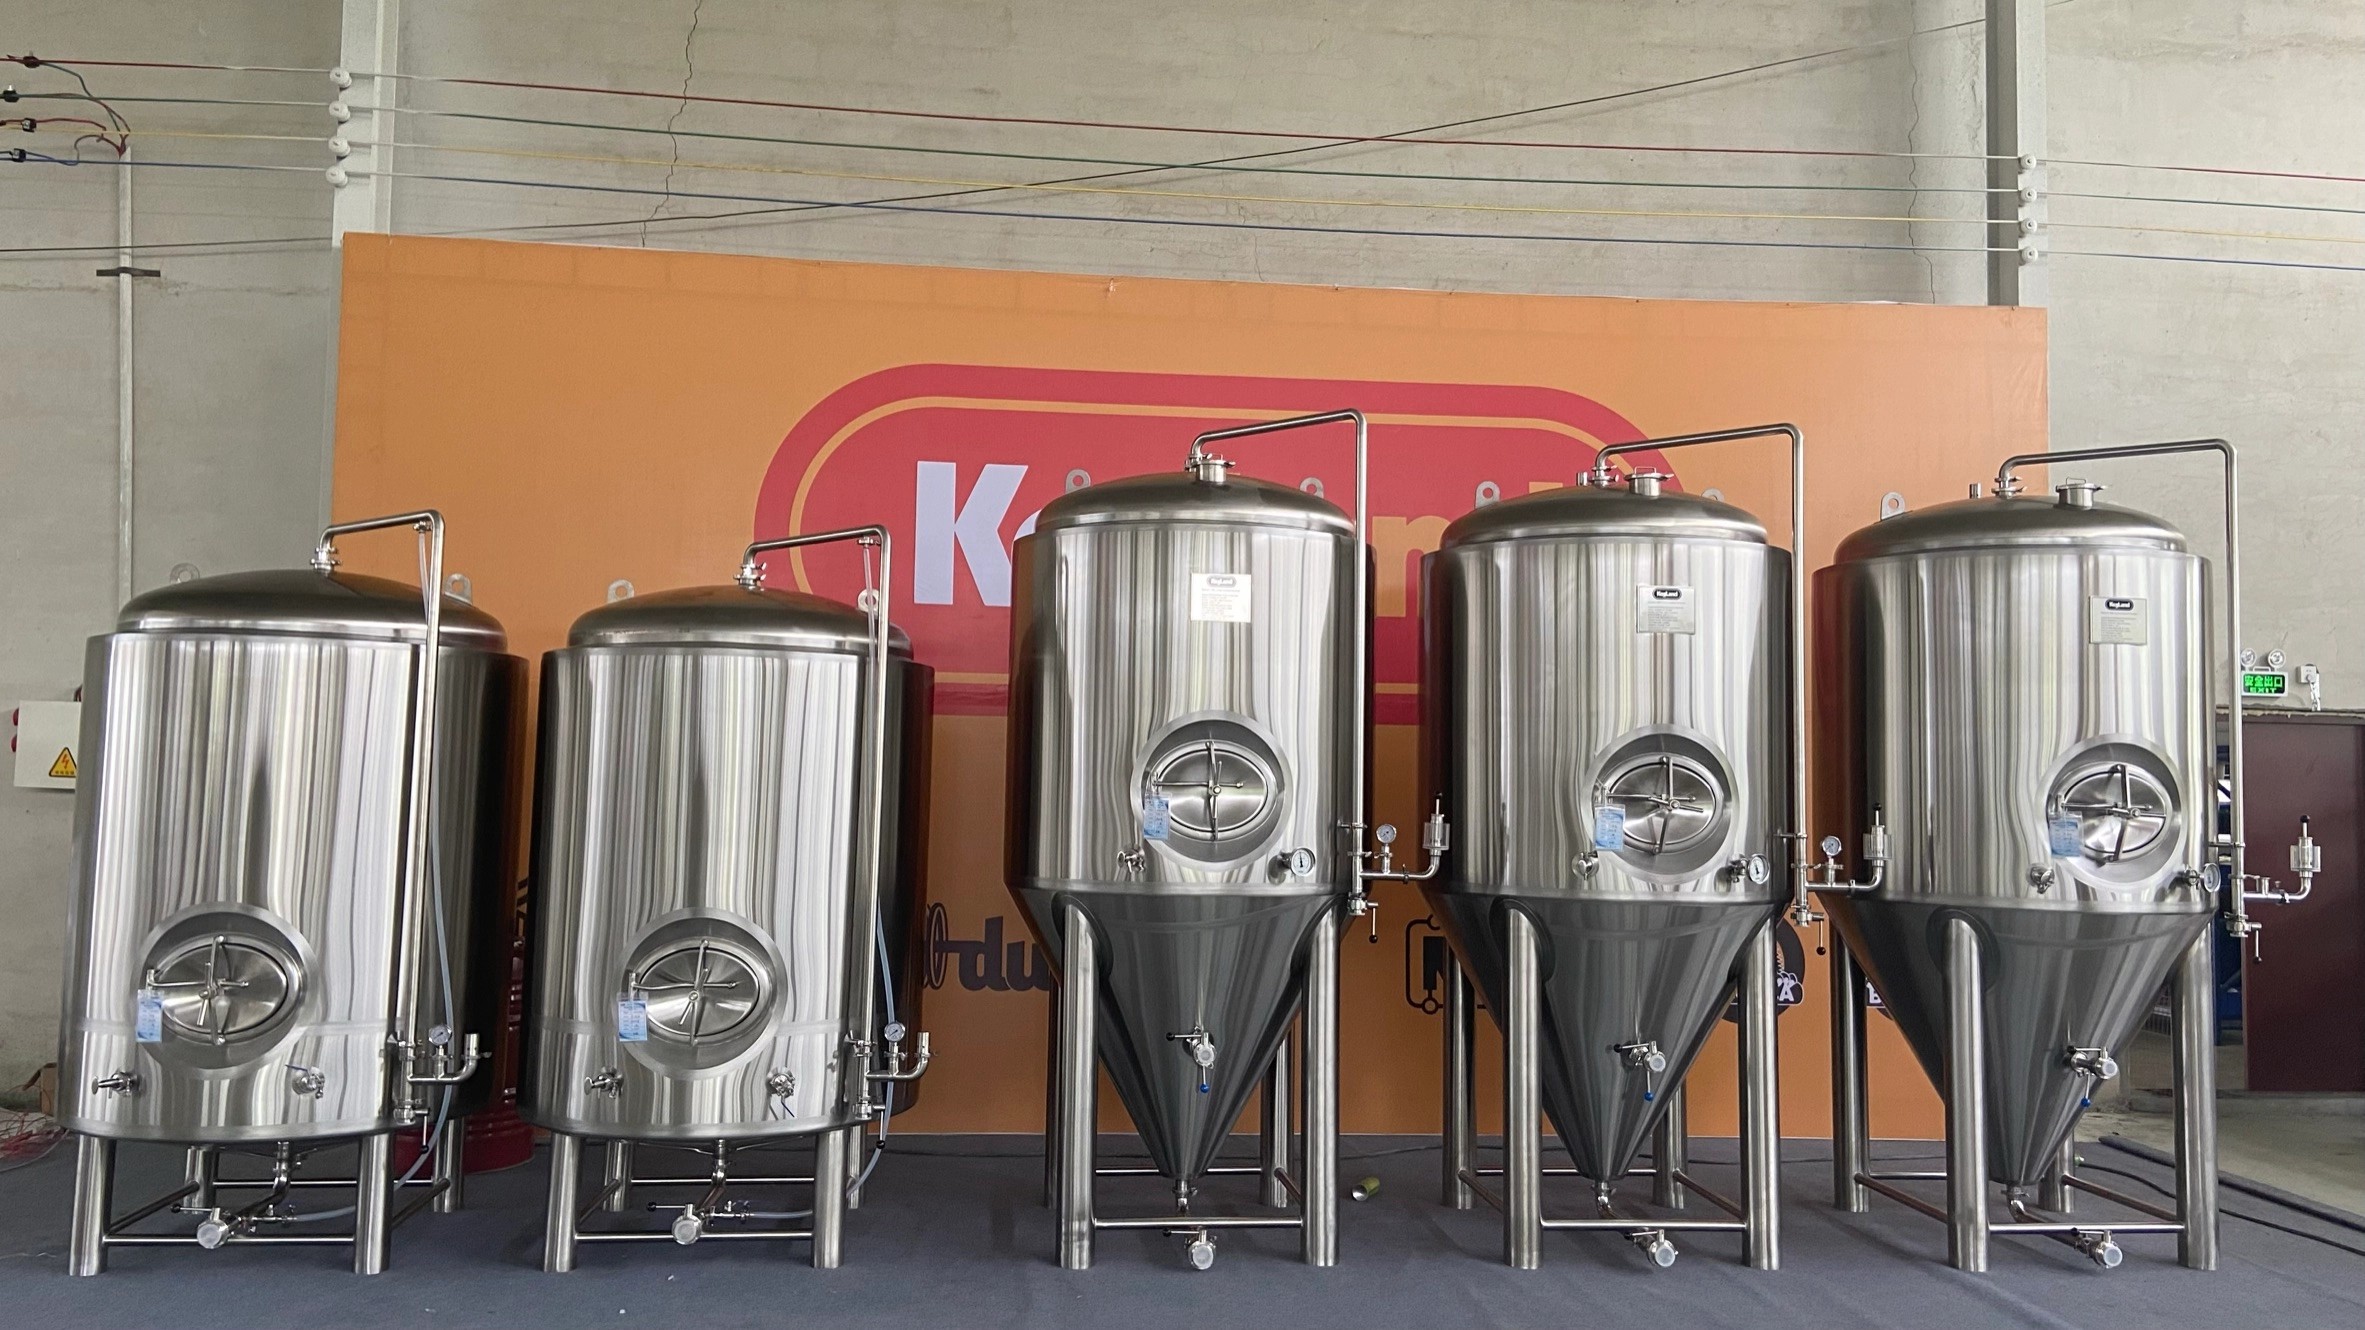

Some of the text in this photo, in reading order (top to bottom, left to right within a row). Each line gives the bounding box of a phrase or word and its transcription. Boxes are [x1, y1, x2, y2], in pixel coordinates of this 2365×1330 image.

[1656, 590, 1679, 598] KegLand
[2244, 675, 2283, 687] 安全出口
